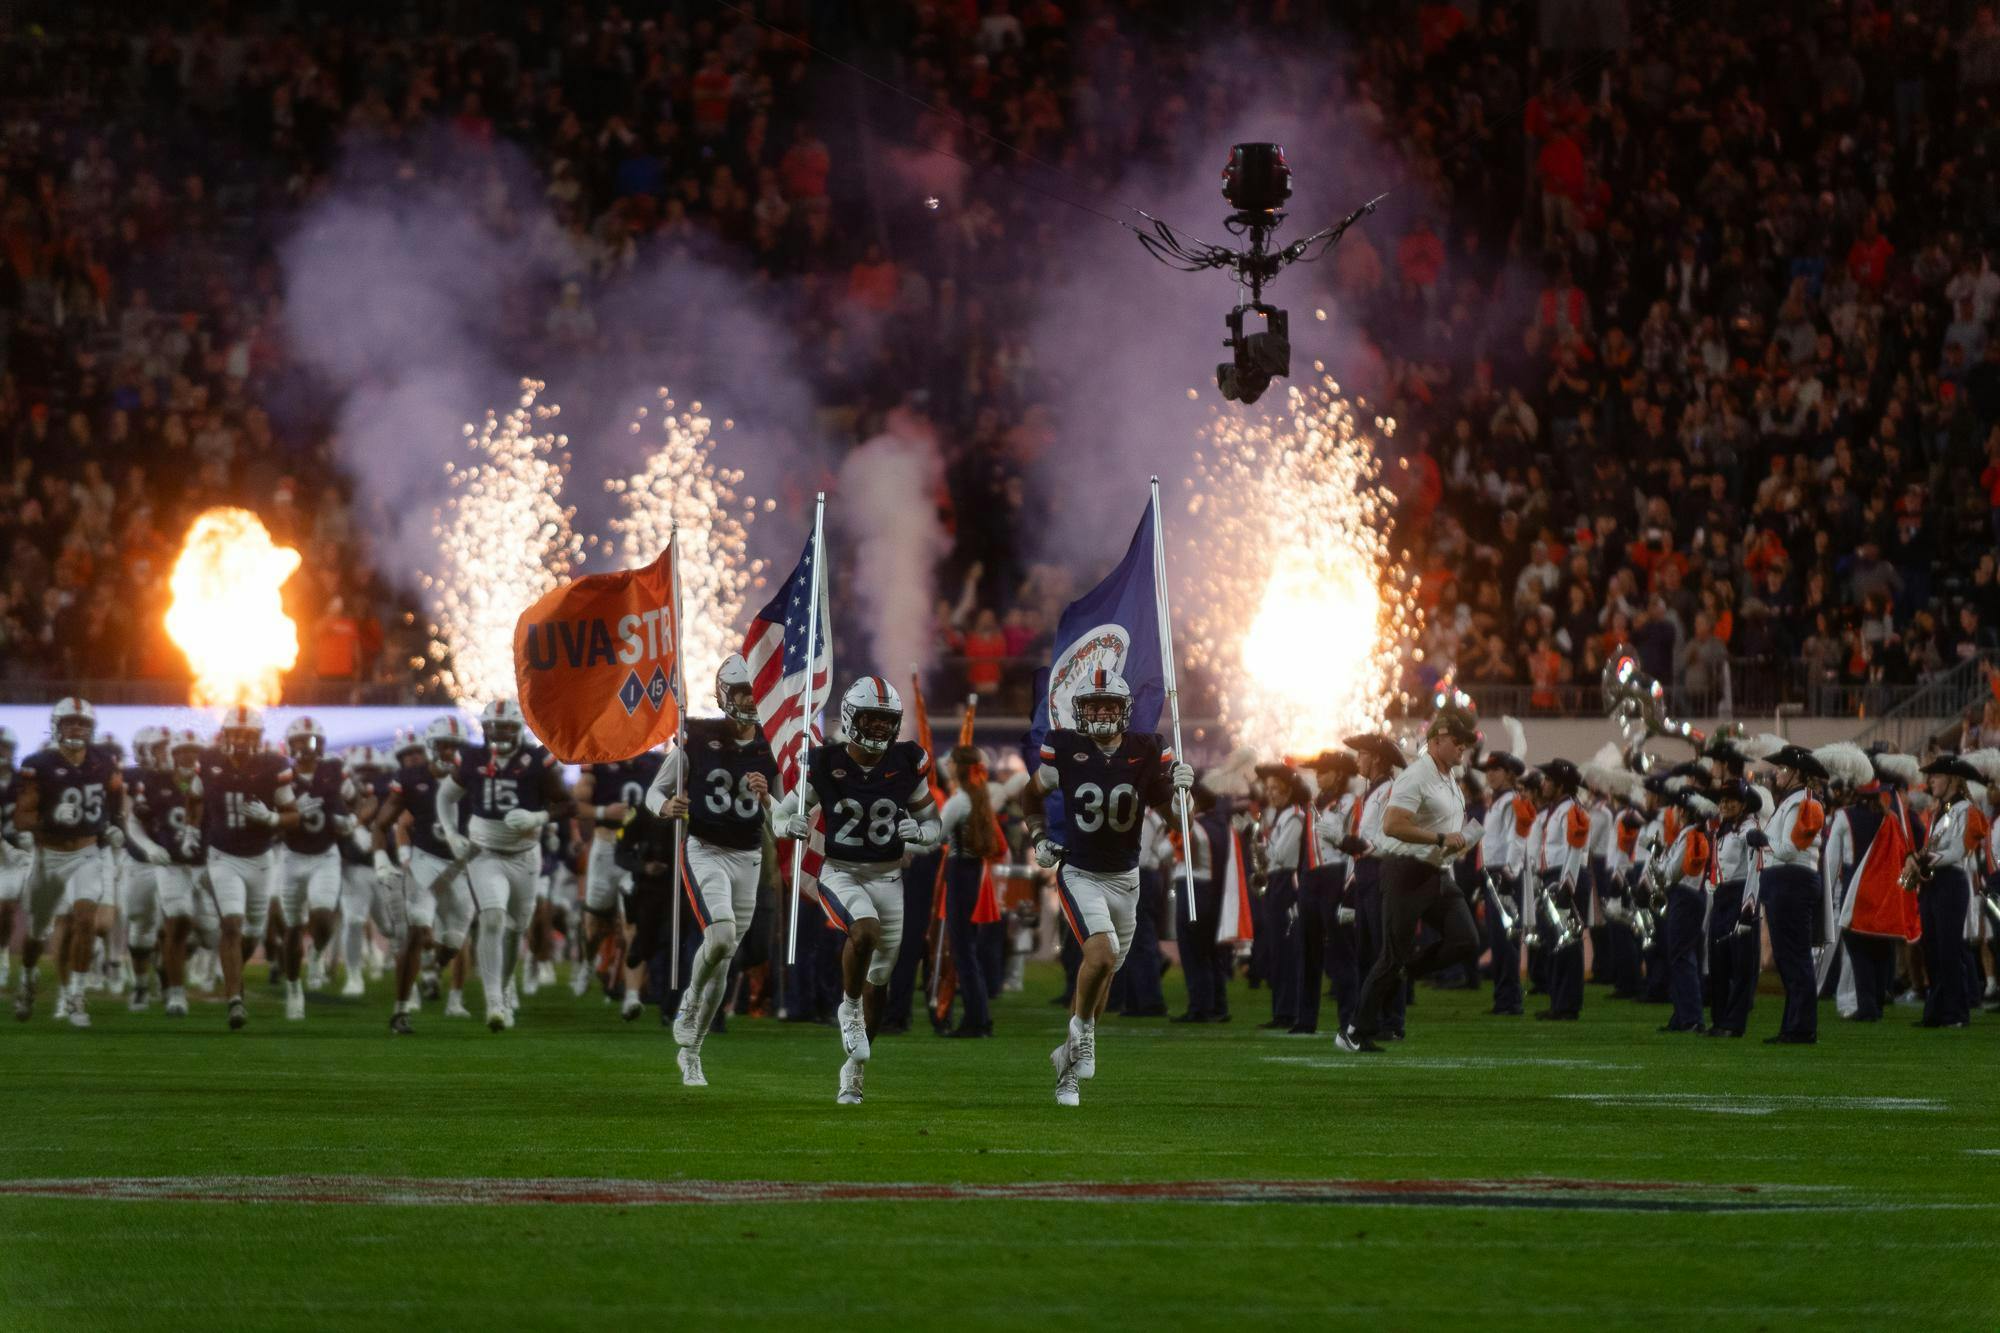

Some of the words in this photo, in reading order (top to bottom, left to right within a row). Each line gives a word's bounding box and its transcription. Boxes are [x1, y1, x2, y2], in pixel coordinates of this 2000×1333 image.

[630, 685, 635, 702] 1
[651, 678, 664, 697] 15
[61, 783, 103, 825] 85
[224, 791, 246, 829] 11
[483, 778, 519, 811] 15
[705, 768, 760, 818] 38
[1074, 782, 1138, 833] 30
[833, 798, 898, 846] 28
